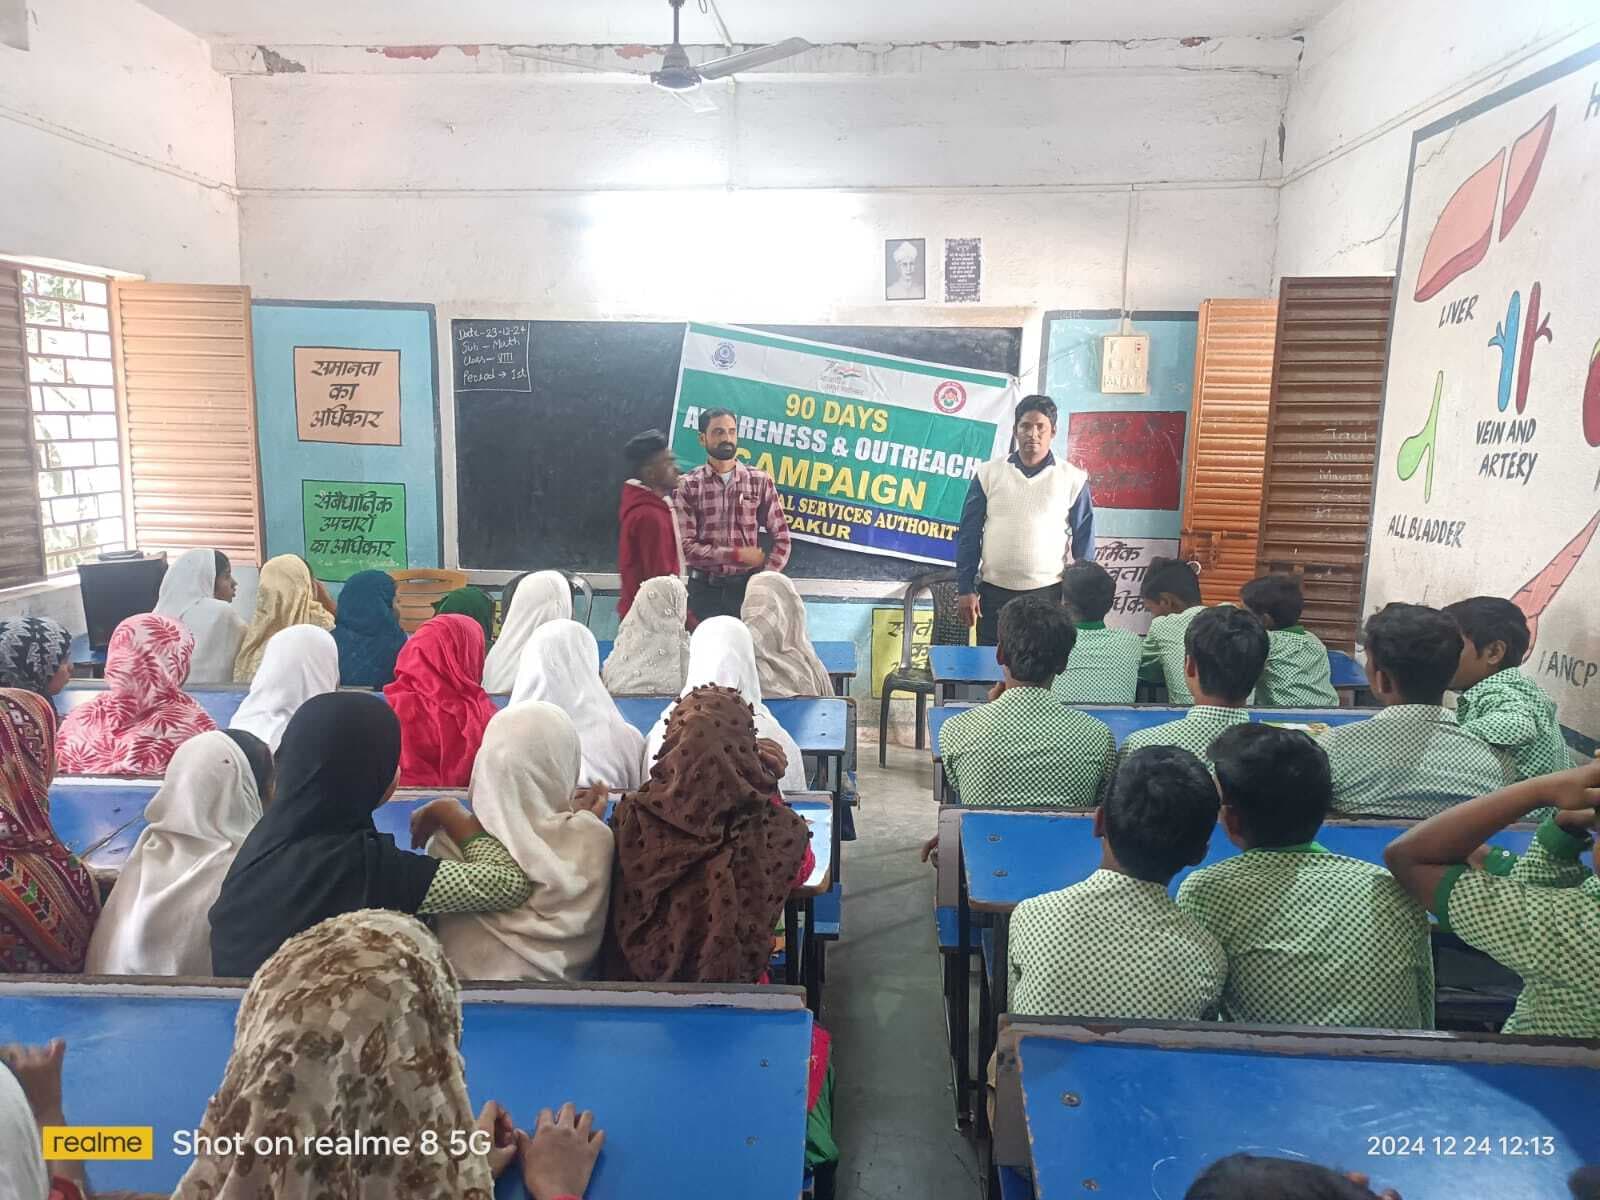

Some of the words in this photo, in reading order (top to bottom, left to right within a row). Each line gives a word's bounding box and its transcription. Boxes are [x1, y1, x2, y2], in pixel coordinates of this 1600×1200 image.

[1439, 295, 1479, 328] LIVER
[311, 361, 383, 377] समानता
[329, 383, 360, 401] का
[310, 404, 384, 428] अधिकार
[786, 393, 816, 420] 90
[822, 400, 889, 433] DAYS
[683, 405, 828, 453] ARENESS
[832, 436, 849, 458] &
[854, 437, 983, 481] OUTREACH
[1476, 420, 1506, 445] VEIN
[1505, 418, 1537, 446] AND
[1478, 451, 1538, 486] ARTERY
[319, 513, 377, 533] उपचारों
[784, 514, 851, 540] PAKUR
[798, 497, 873, 526] SERVICES
[874, 512, 960, 541] AUTHORIT
[310, 539, 330, 555] का
[331, 535, 397, 557] अधिकार
